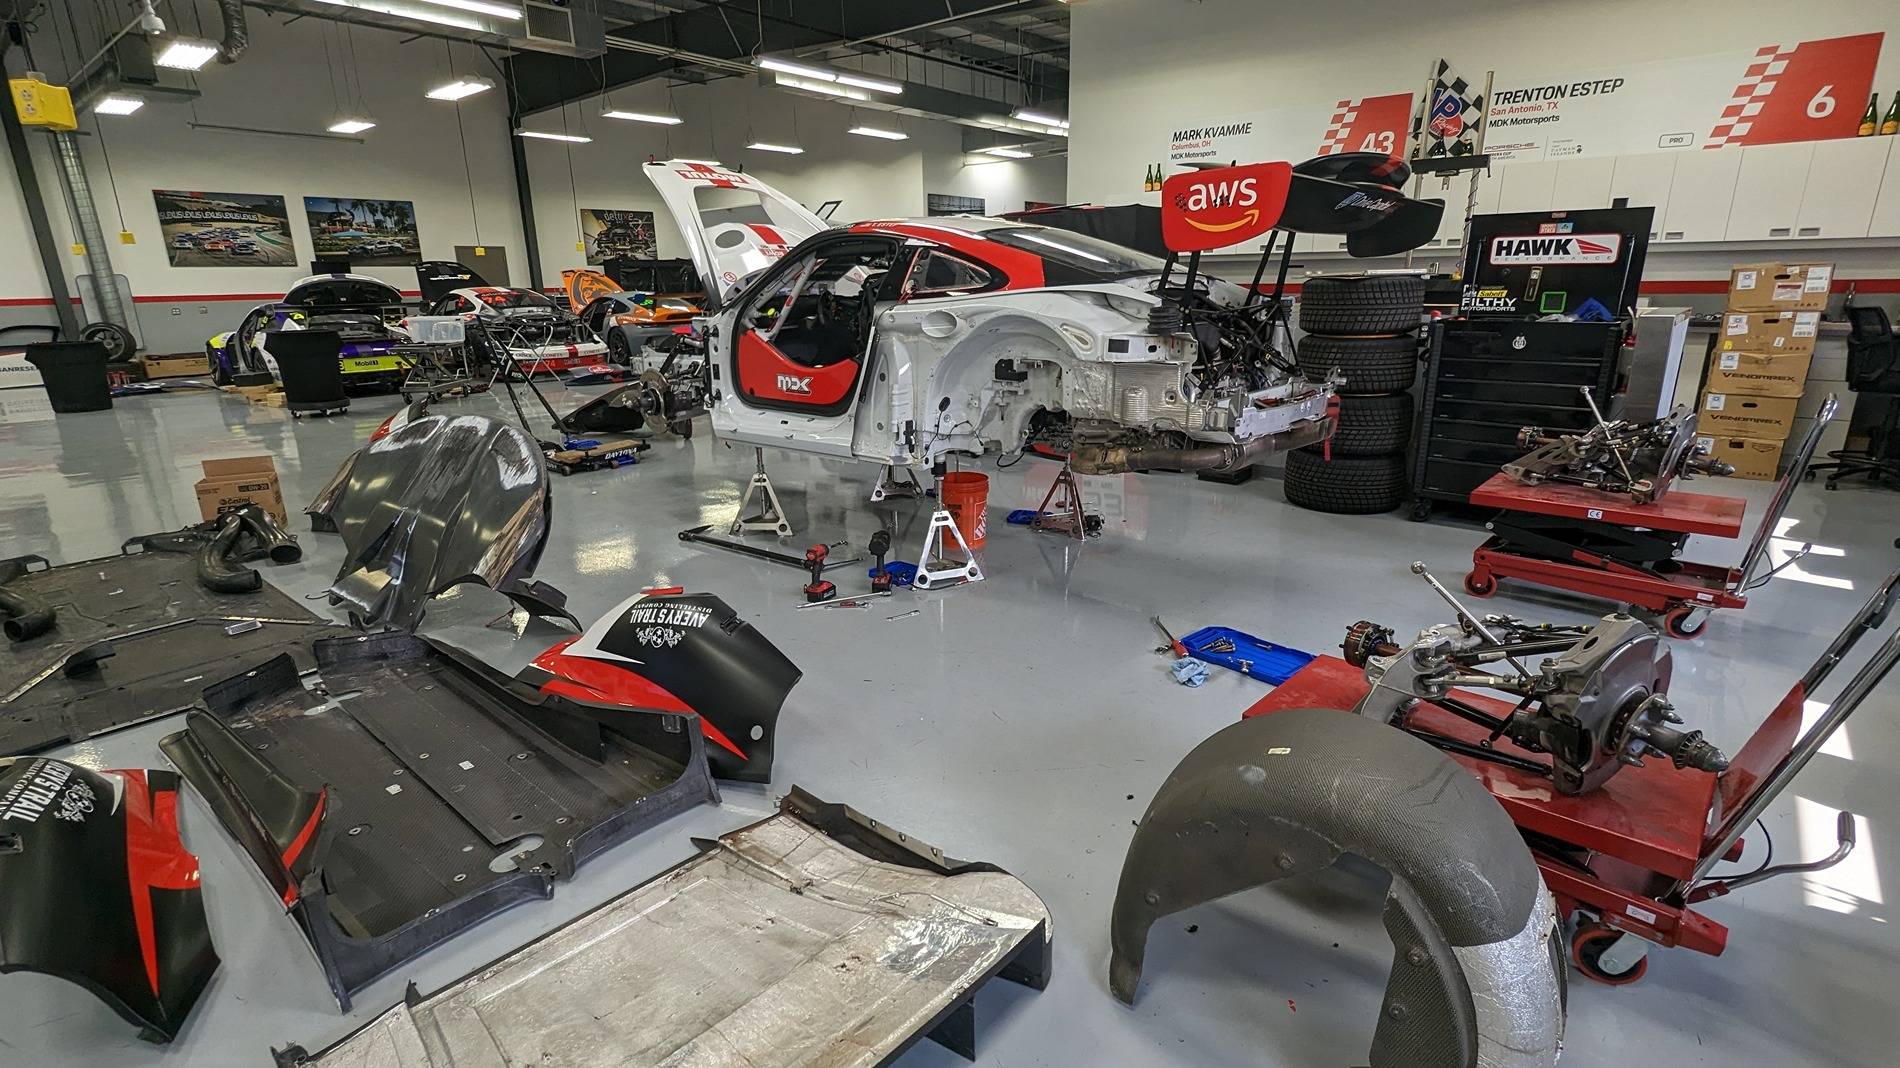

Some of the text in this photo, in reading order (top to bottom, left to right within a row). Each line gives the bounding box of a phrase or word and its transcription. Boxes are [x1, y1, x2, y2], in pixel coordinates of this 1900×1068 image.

[1493, 77, 1624, 106] TRENTON ESTEP
[1806, 84, 1836, 119] 6
[1490, 101, 1559, 117] San Antonio, TX
[1488, 114, 1560, 128] MDK Motorsports
[1172, 122, 1253, 143] MARK KVAMME
[1171, 140, 1212, 151] Columbus, OH
[1359, 131, 1395, 155] 43
[1484, 142, 1536, 151] PORSCHE
[1668, 136, 1684, 144] PRO
[1170, 149, 1217, 160] MDK Motorsports
[1187, 177, 1258, 212] aws
[604, 211, 633, 221] deluxe
[1495, 238, 1575, 256] HAWK
[1461, 297, 1517, 307] FILTHY
[1721, 372, 1796, 382] VENOMREX
[1710, 413, 1783, 426] VENOMREX
[666, 602, 713, 614] DISTILLING
[630, 608, 711, 628] AVERYS TRAIL
[2, 791, 57, 823] TRAIL
